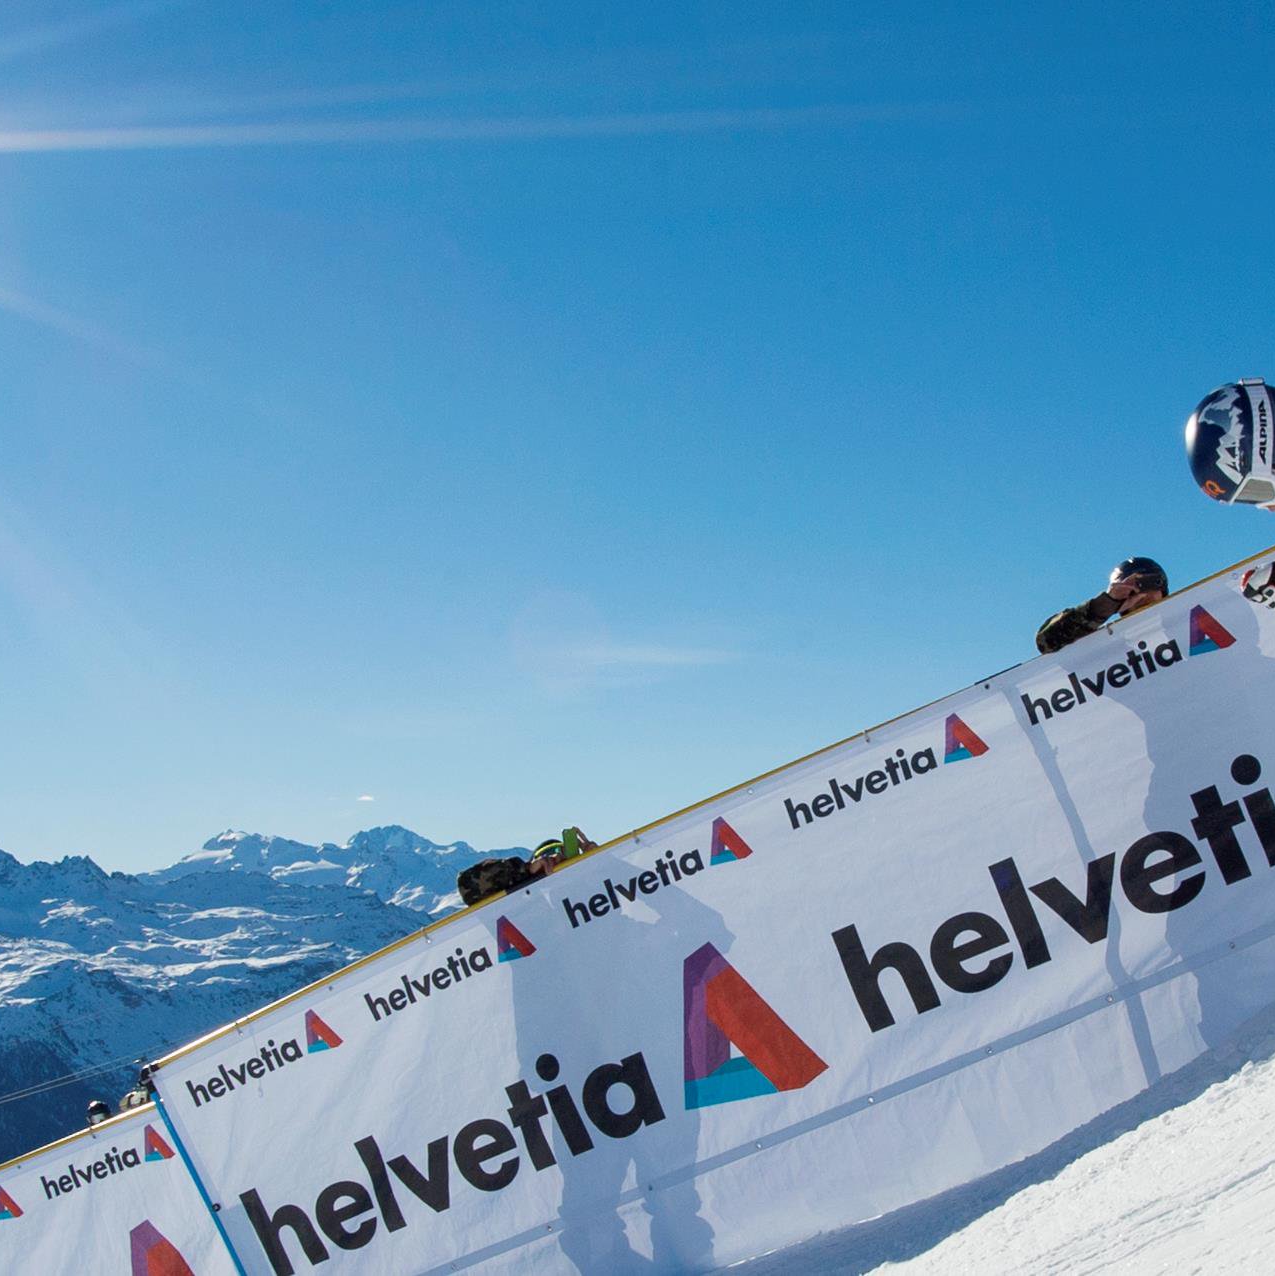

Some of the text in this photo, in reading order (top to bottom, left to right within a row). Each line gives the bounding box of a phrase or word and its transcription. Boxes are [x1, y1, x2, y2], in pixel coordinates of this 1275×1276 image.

[1257, 399, 1269, 465] ALPINA
[1021, 638, 1183, 726] helvetia
[784, 746, 937, 830] helvetia
[562, 849, 705, 929] helvetia
[364, 946, 494, 1022] helvetia
[185, 1038, 304, 1108] helvetia
[40, 1146, 141, 1200] helvetia
[239, 1052, 666, 1276] helvetia
